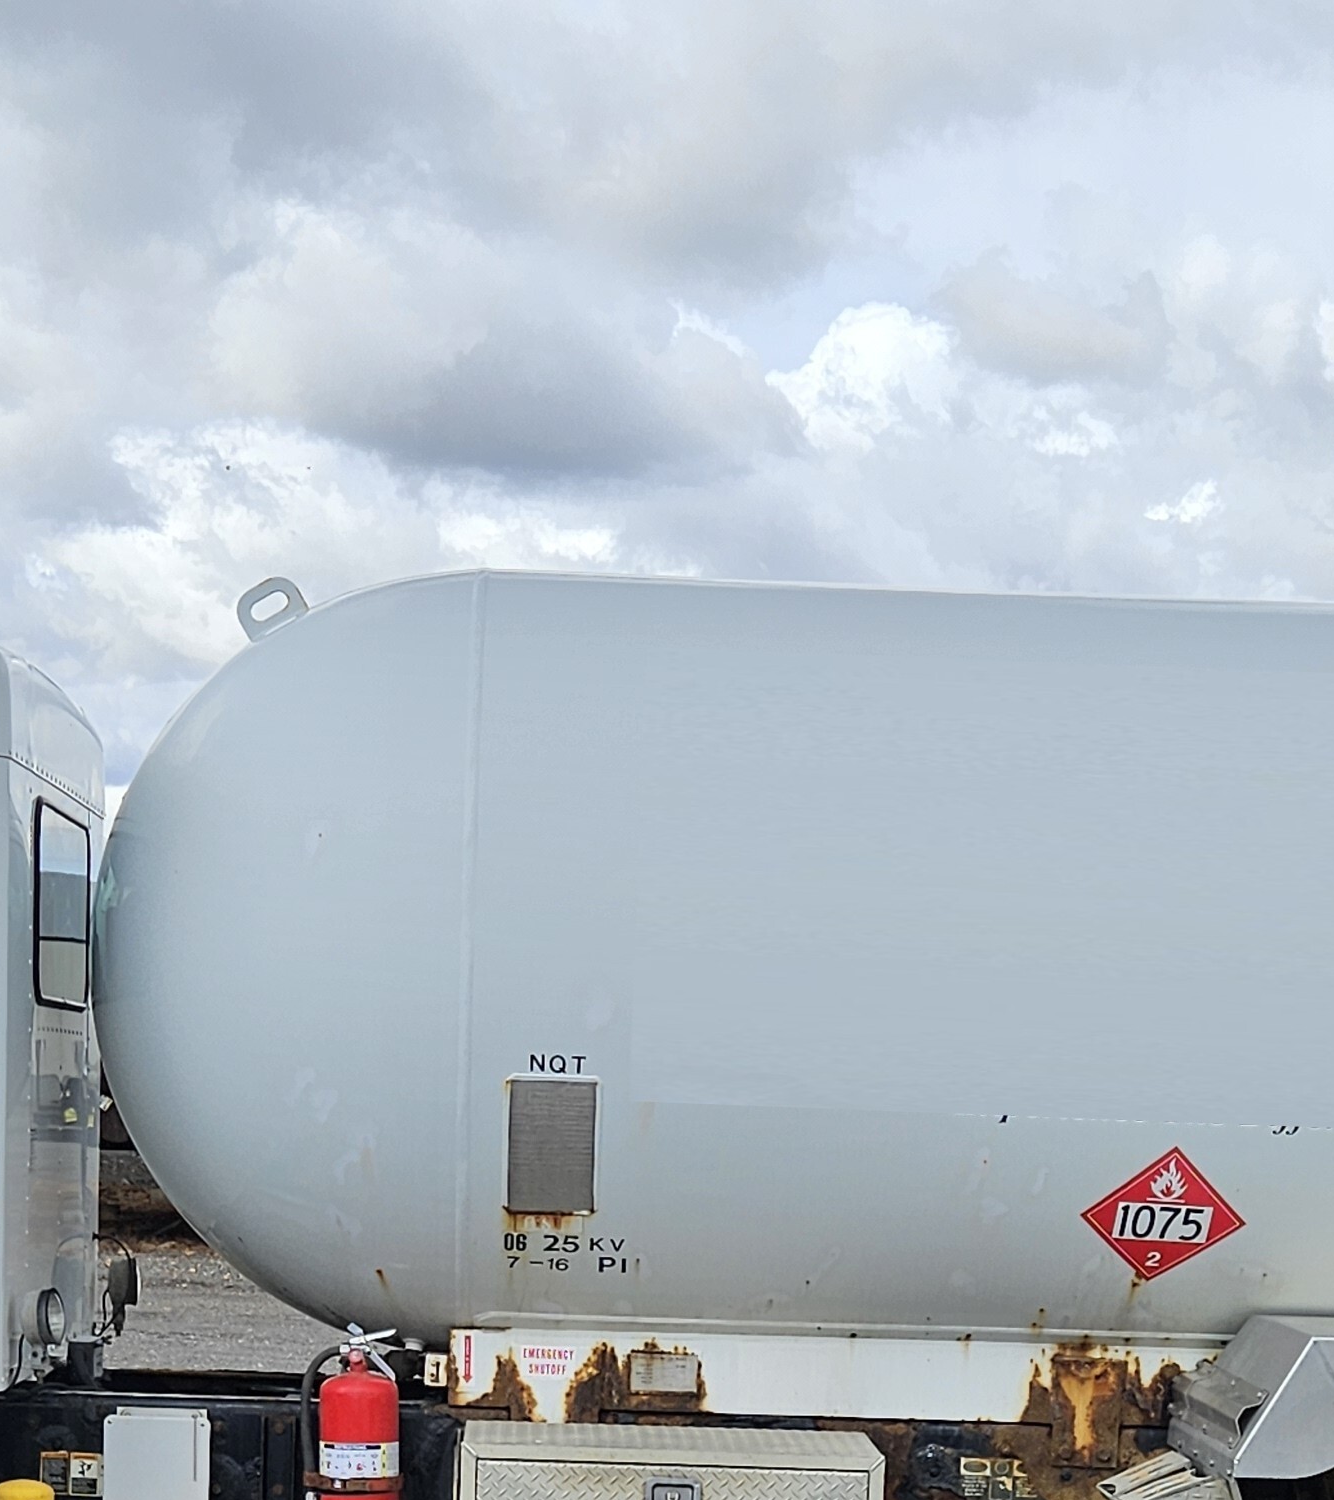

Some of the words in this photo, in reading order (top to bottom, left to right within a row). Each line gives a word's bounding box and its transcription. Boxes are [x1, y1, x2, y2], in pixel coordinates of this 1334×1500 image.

[529, 1054, 587, 1074] NQT
[1118, 1204, 1205, 1241] 1075
[542, 1234, 580, 1253] 25
[1144, 1251, 1162, 1267] 2
[523, 1347, 575, 1361] EMERGENCY
[528, 1362, 567, 1376] SHUTOFF
